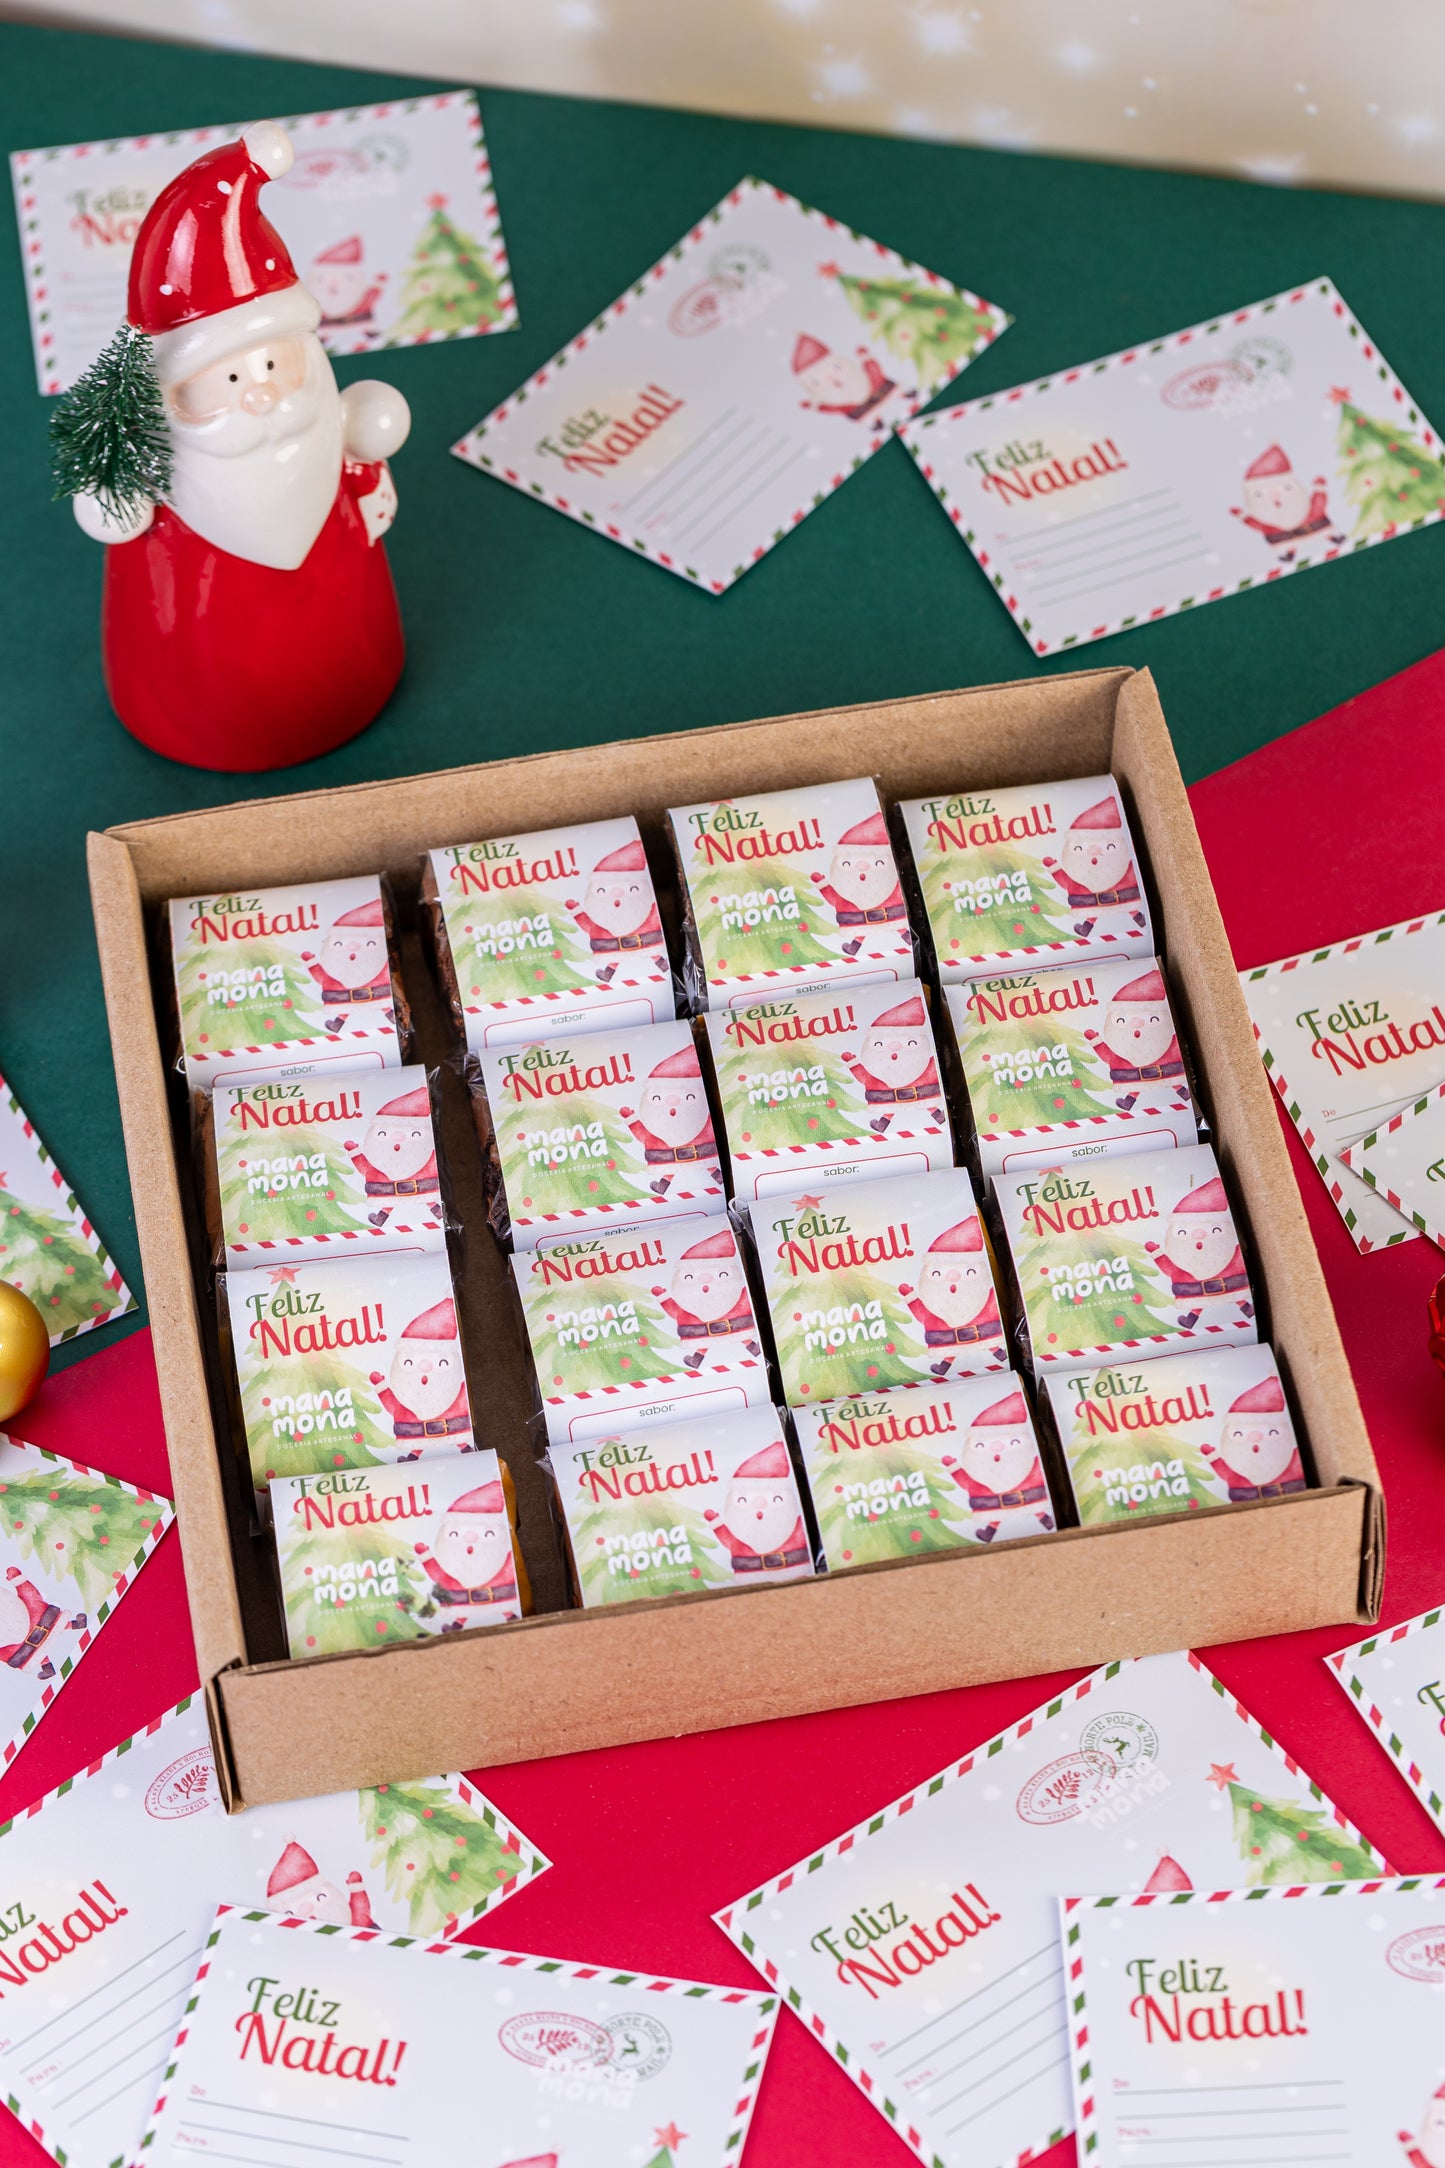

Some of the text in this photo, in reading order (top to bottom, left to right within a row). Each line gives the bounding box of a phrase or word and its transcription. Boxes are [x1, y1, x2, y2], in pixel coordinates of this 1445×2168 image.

[536, 408, 610, 460] Feliz
[563, 384, 685, 477] Natal!
[967, 439, 1053, 476] Feliz
[982, 438, 1129, 506] Natal!
[689, 809, 763, 835] Feliz
[922, 798, 995, 822] Feliz
[695, 819, 824, 865] Natal!
[928, 804, 1056, 852] Natal!
[445, 840, 519, 865] Feliz
[450, 848, 580, 895] Natal!
[950, 871, 1028, 896] mana
[190, 898, 262, 917] Feliz
[718, 886, 796, 911] mana
[954, 885, 1032, 913] mona
[191, 904, 320, 944] Natal!
[471, 914, 550, 940] mana
[722, 903, 799, 930] mona
[476, 930, 554, 957] mona
[207, 964, 283, 986] mana
[796, 983, 830, 994] sabor:
[208, 979, 286, 1006] mona
[967, 978, 1098, 1025] Natal!
[552, 1013, 585, 1024] sabor:
[722, 1002, 797, 1023] Feliz
[726, 1006, 858, 1047] Natal!
[1296, 1000, 1389, 1040] Feliz
[1312, 1006, 1445, 1076] Natal
[498, 1049, 574, 1074] Feliz
[989, 1043, 1069, 1070] mana
[280, 1066, 315, 1077] sabor:
[503, 1053, 635, 1102] Natal!
[746, 1065, 825, 1088] mana
[993, 1060, 1073, 1086] mona
[228, 1082, 304, 1103] Feliz
[748, 1082, 829, 1105] mona
[230, 1091, 363, 1130] Natal!
[524, 1122, 604, 1149] mana
[246, 1152, 326, 1175] mana
[527, 1140, 608, 1167] mona
[1072, 1145, 1107, 1157] sabor:
[247, 1170, 329, 1194] mona
[824, 1165, 859, 1176] sabor:
[1016, 1178, 1095, 1207] Feliz
[1022, 1186, 1159, 1236] Natal!
[773, 1213, 851, 1242] Feliz
[532, 1240, 667, 1286] Natal!
[777, 1223, 914, 1276] Natal!
[1048, 1257, 1129, 1284] mana
[1052, 1273, 1134, 1301] mona
[246, 1289, 324, 1322] Feliz
[554, 1300, 636, 1329] mana
[800, 1299, 882, 1331] mana
[249, 1304, 387, 1359] Natal!
[558, 1319, 640, 1347] mona
[805, 1319, 887, 1352] mona
[1068, 1373, 1148, 1400] Feliz
[270, 1387, 352, 1416] mana
[640, 1404, 676, 1416] sabor:
[813, 1399, 892, 1426] Feliz
[1075, 1384, 1214, 1435] Natal!
[272, 1406, 356, 1439] mona
[818, 1402, 957, 1453] Natal!
[573, 1442, 652, 1472] Feliz
[290, 1474, 370, 1497] Feliz
[579, 1450, 718, 1502] Natal!
[841, 1470, 926, 1500] mana
[1101, 1459, 1185, 1486] mana
[846, 1490, 930, 1520] mona
[1106, 1478, 1190, 1506] mona
[294, 1484, 432, 1531] Natal!
[605, 1525, 687, 1554] mana
[312, 1557, 397, 1582] mana
[608, 1544, 692, 1575] mona
[314, 1576, 399, 1604] mona
[166, 1792, 179, 1803] 25
[810, 1901, 909, 1963] Feliz
[837, 1883, 1001, 2000] Natal!
[1126, 1958, 1228, 1995] Feliz
[247, 1977, 342, 2027] Feliz
[1130, 1989, 1308, 2044] Natal!
[236, 2011, 408, 2087] Natal!
